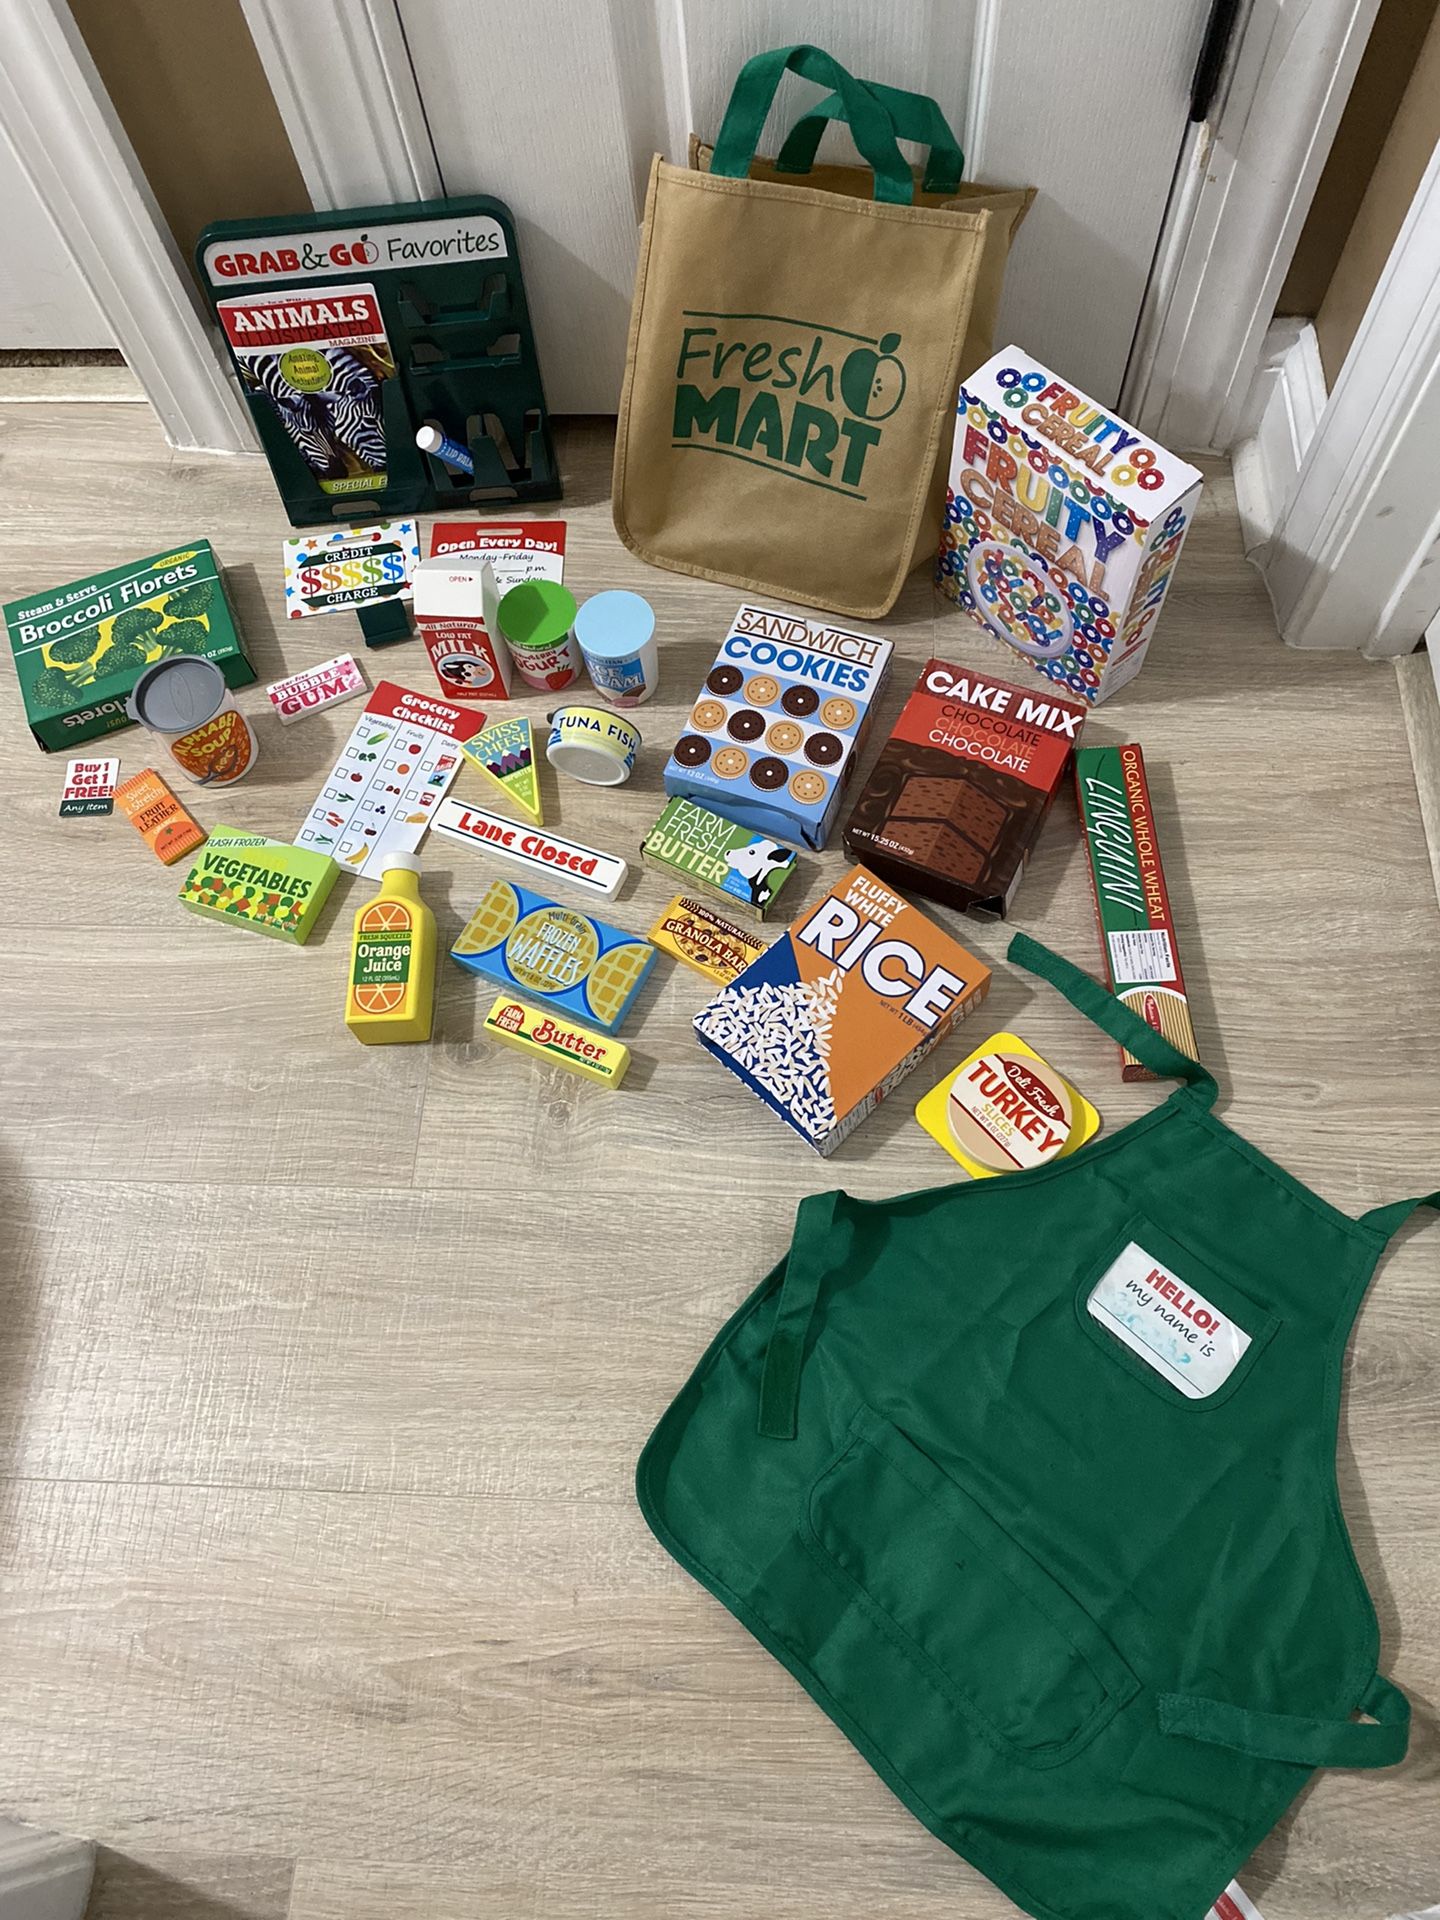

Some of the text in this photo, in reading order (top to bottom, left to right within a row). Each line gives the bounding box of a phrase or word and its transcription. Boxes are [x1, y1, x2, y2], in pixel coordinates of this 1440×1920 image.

[387, 229, 500, 262] Favorites
[233, 300, 370, 332] ANIMALS
[237, 321, 375, 346] ILLUSTRATED
[329, 336, 377, 347] MAGAZINE
[676, 327, 834, 402] Fresh
[672, 384, 882, 487] MART
[1036, 382, 1141, 455] FRUITY
[444, 446, 459, 461] LIP
[1021, 402, 1115, 477] CEREAL
[332, 479, 373, 492] SPECIAL
[962, 424, 1126, 564] FRUITY
[436, 537, 558, 554] Open Every Day!
[959, 468, 1110, 602] CEREAL
[158, 551, 192, 568] ORGANIC
[324, 546, 374, 563] CREDIT
[17, 583, 99, 620] Steam & Serve
[18, 563, 199, 646] Broccoli Florets
[326, 587, 379, 604] CHARGE
[439, 621, 478, 629] Natural
[736, 612, 880, 664] SANDWICH
[430, 639, 491, 661] MILK
[724, 635, 870, 693] COOKIES
[275, 667, 341, 701] BUBBLE
[281, 677, 348, 715] GUM
[391, 706, 455, 734] Checklist
[400, 693, 461, 720] Grocery
[925, 670, 1084, 739] CAKE MIX
[172, 712, 238, 757] ALPHABET
[364, 714, 396, 732] Vegetables
[471, 721, 521, 750] SWISS
[558, 715, 636, 752] TUNA FISH
[935, 716, 1035, 760] CHOCOLATE
[941, 704, 1042, 747] CHOCOLATE
[189, 727, 232, 757] SOUP
[440, 739, 459, 750] Dairy
[475, 730, 529, 761] CHEESE
[928, 728, 1031, 774] CHOCOLATE
[72, 773, 109, 786] Get 1
[74, 762, 110, 773] Buy 1
[63, 785, 115, 799] FREE!
[63, 802, 85, 814] Any
[126, 783, 150, 802] Sweet
[138, 803, 179, 833] LEATHER
[139, 801, 168, 822] FRUIT
[673, 799, 738, 842] FARM
[205, 837, 268, 848] FLASH FROZEN
[457, 811, 599, 876] Lane Closed
[663, 815, 728, 858] FRESH
[852, 827, 862, 836] NET
[889, 839, 900, 850] OZ
[1085, 777, 1144, 913] LINGUINI
[1122, 750, 1166, 922] ORGANIC WHOLE WHEAT
[646, 830, 729, 884] BUTTER
[202, 851, 313, 900] VEGETABLES
[844, 888, 896, 928] WHITE
[851, 875, 909, 915] FLUFFY
[379, 933, 412, 941] SQUEEZED
[535, 921, 582, 955] FROZEN
[698, 907, 745, 940] 100% NATURAL
[357, 943, 411, 960] Orange
[507, 933, 584, 986] WAFFLES
[665, 919, 748, 973] GRANOLA BAR
[796, 894, 969, 1030] RICE
[362, 957, 402, 974] Juice
[495, 1016, 521, 1033] FRESH
[503, 1005, 524, 1021] FARM
[532, 1019, 607, 1061] Butter
[967, 1059, 1065, 1153] TURKEY
[1007, 1065, 1062, 1118] Deli Fresh
[971, 1105, 981, 1119] NET
[980, 1102, 1016, 1138] SLICES
[1126, 1279, 1153, 1307] my
[1153, 1303, 1199, 1345] name
[1199, 1340, 1216, 1358] is
[1145, 1268, 1221, 1337] HELLO!
